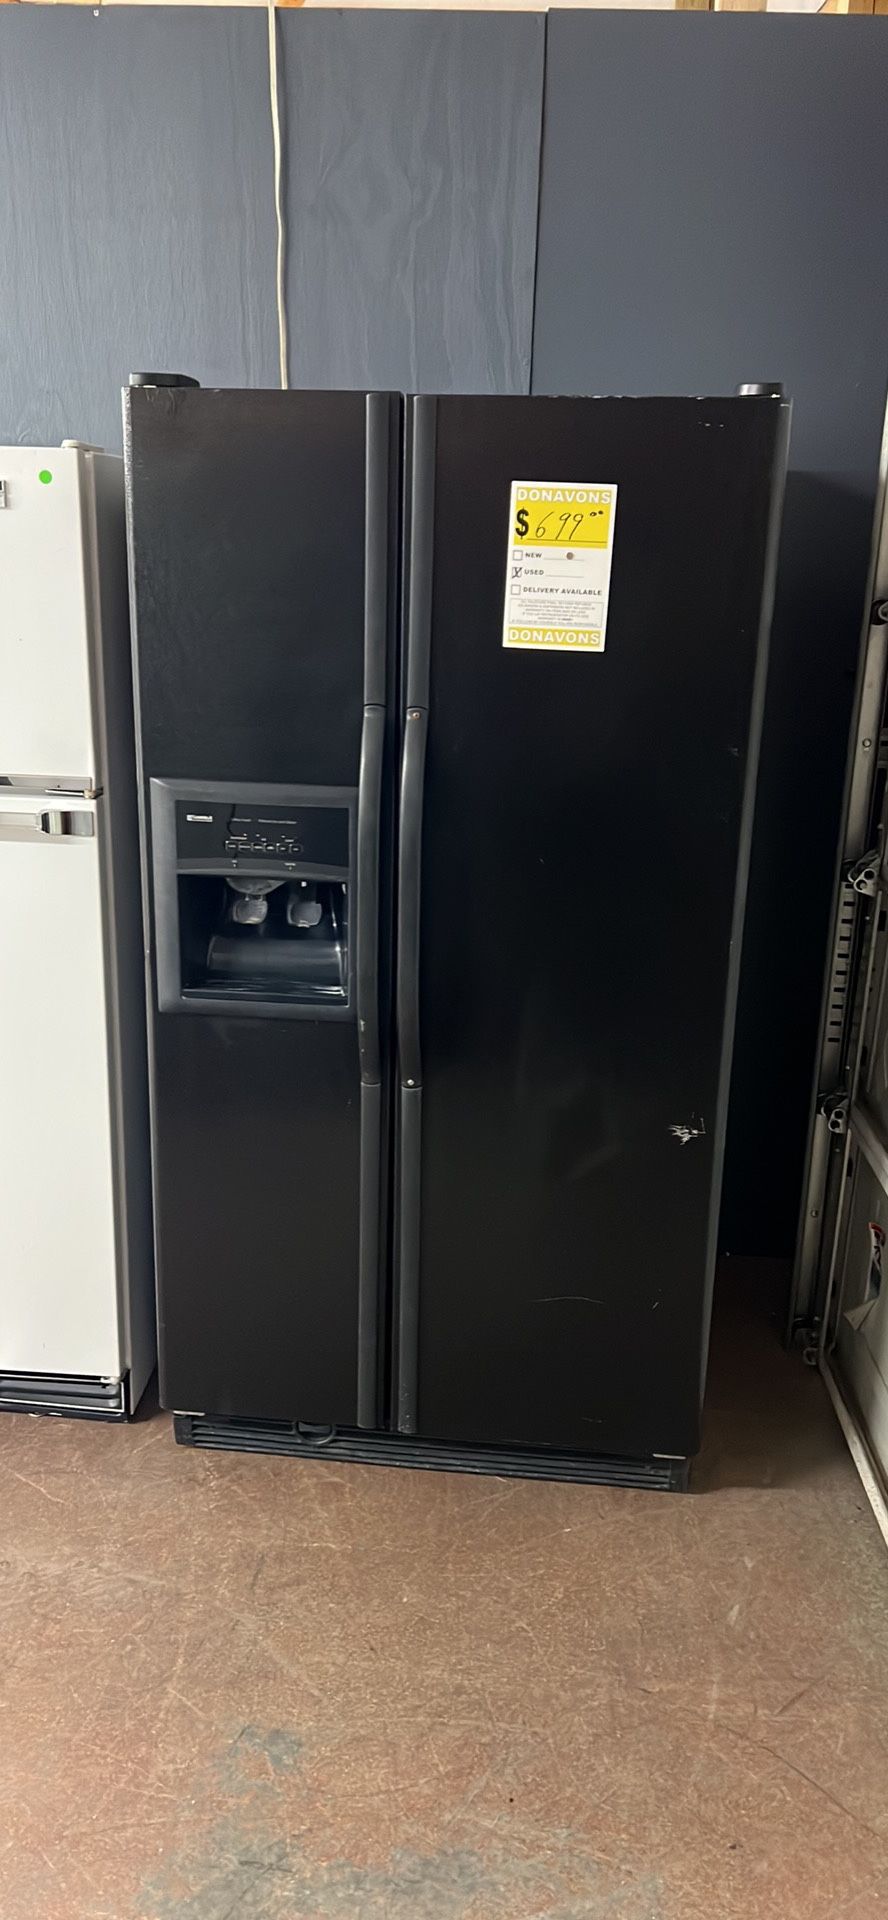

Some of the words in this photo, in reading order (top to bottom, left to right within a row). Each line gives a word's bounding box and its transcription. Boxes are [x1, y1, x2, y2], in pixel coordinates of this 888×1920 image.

[517, 488, 611, 504] DONAVONS
[515, 506, 529, 540] $
[535, 511, 584, 540] 699
[523, 586, 560, 594] DELIVERY
[561, 588, 603, 596] AVAILABLE
[509, 629, 601, 645] DONAVONS
